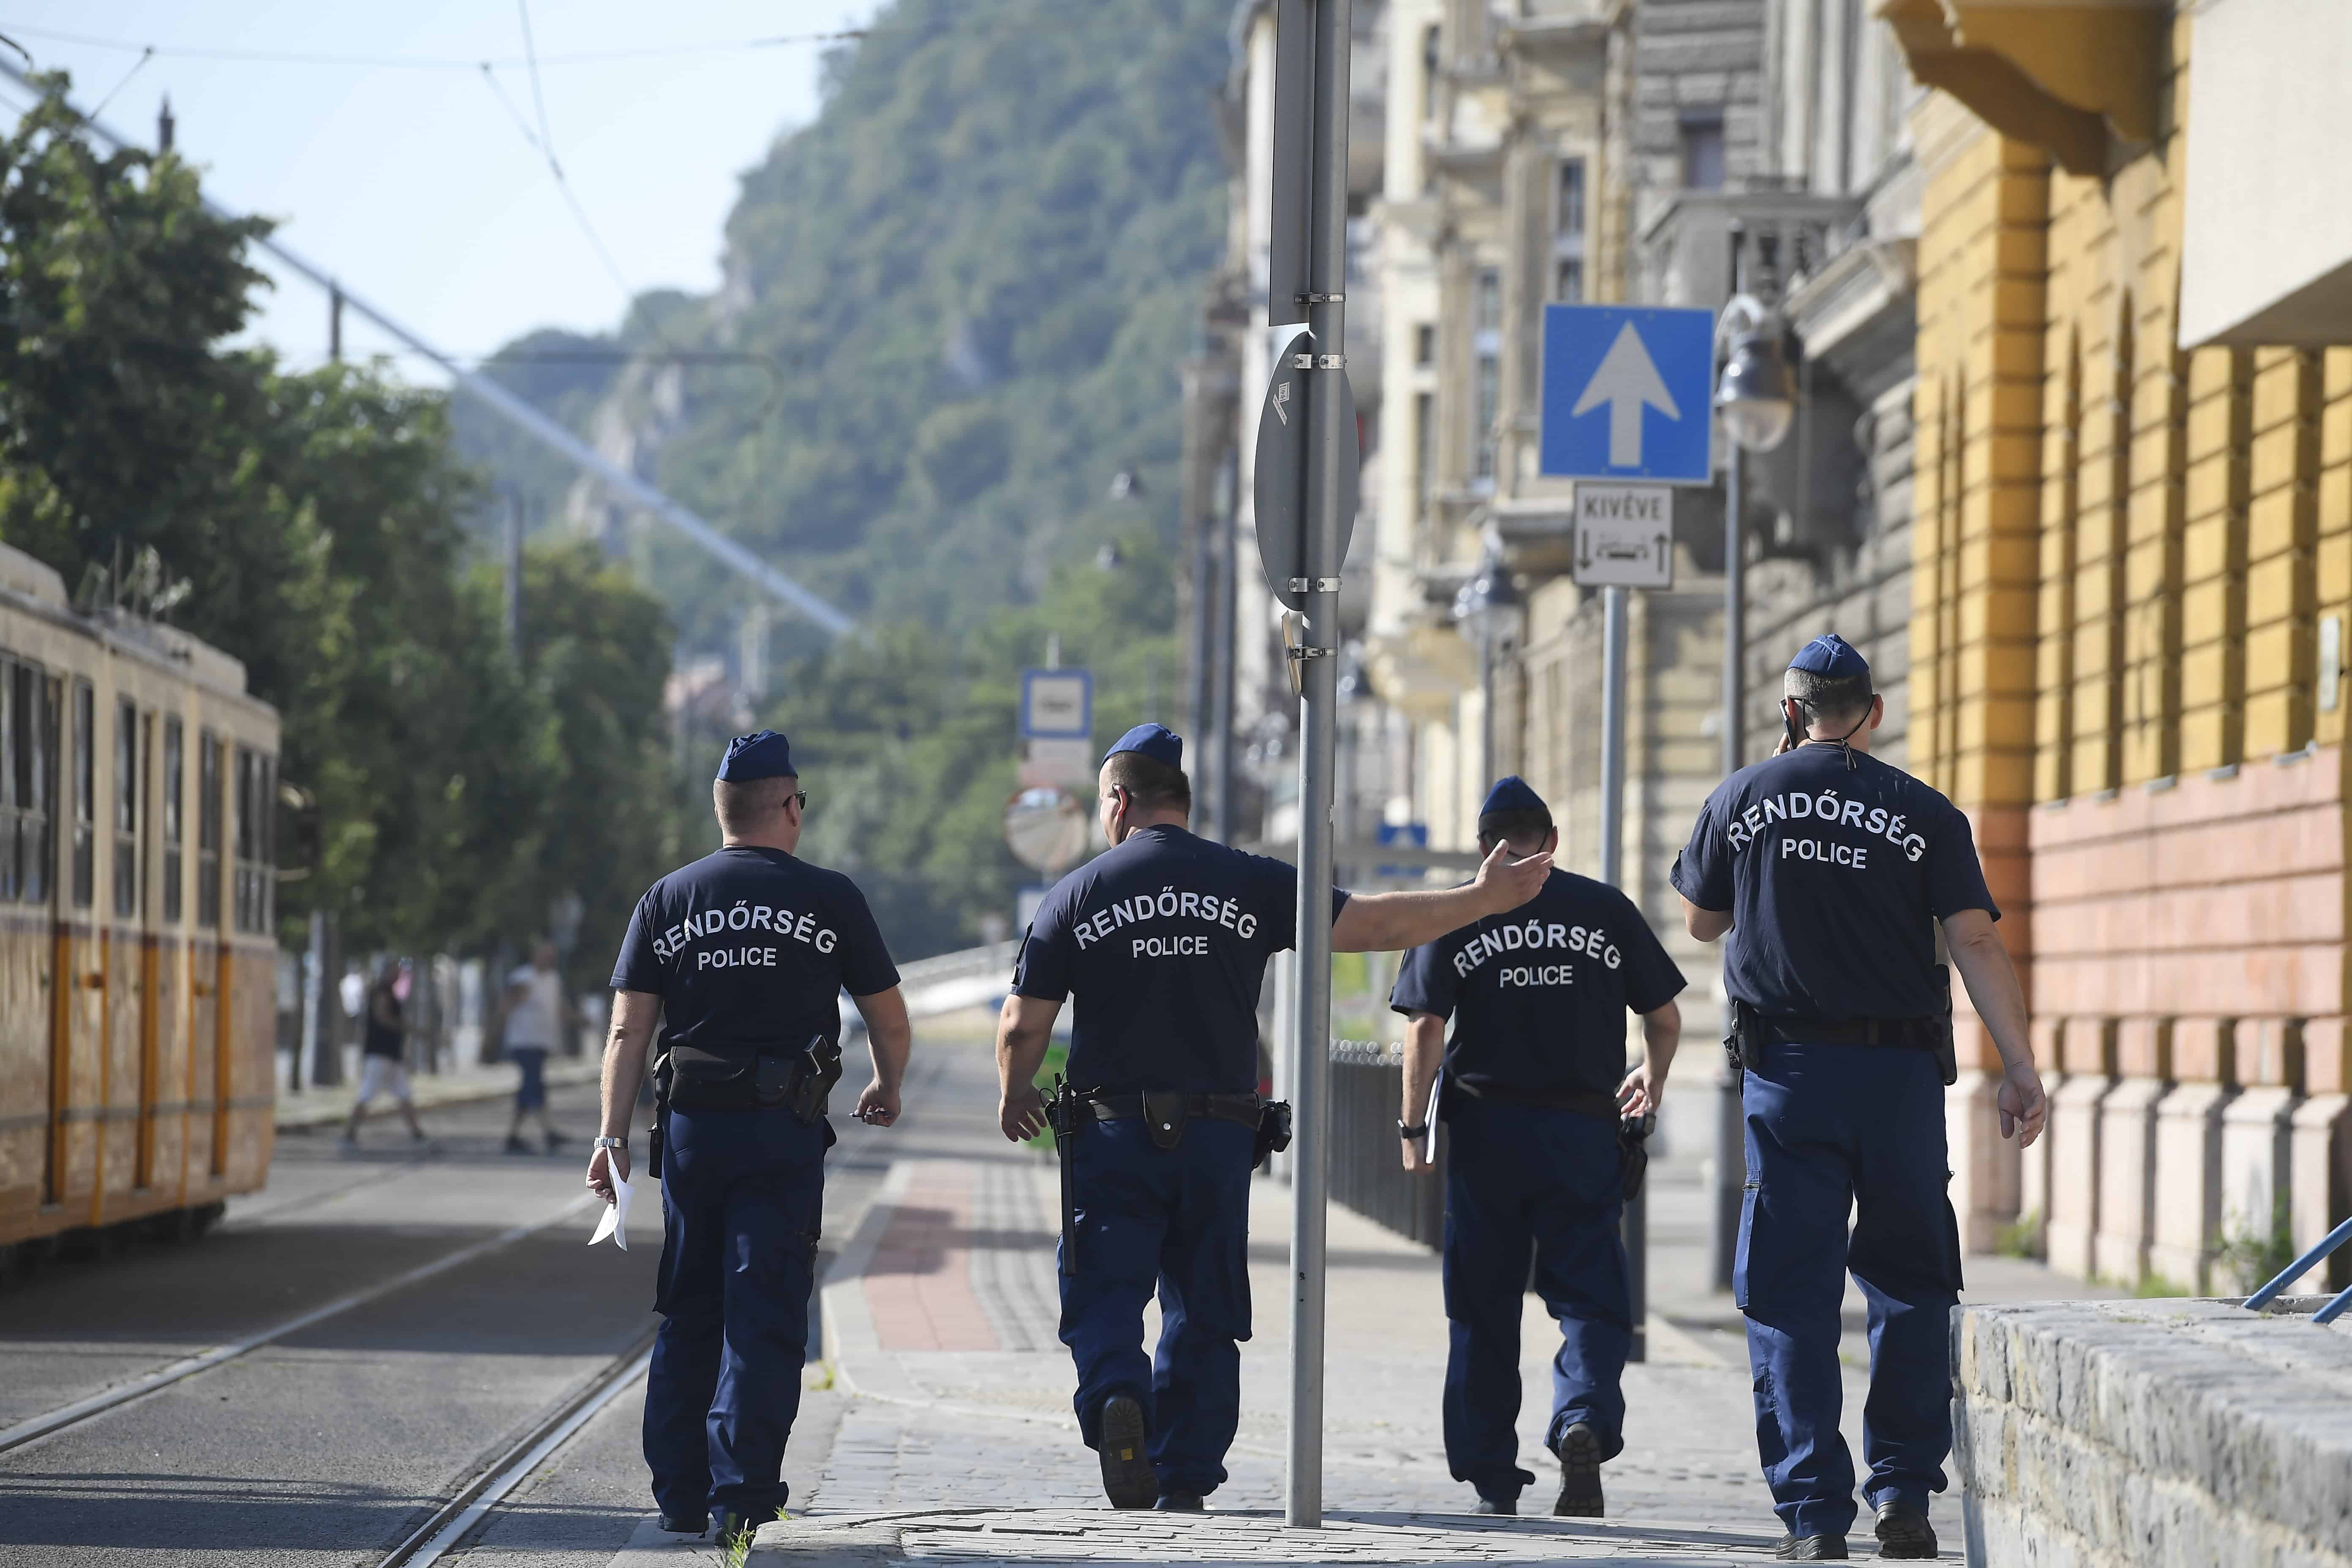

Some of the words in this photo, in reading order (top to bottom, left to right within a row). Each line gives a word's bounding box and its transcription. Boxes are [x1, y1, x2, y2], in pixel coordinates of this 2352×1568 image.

[1584, 491, 1662, 520] KIVÉVE
[1728, 789, 1926, 862] RENDŐRSÉG
[1782, 838, 1867, 869] POLICE
[653, 900, 837, 965] RENDŐRSÉG
[1073, 885, 1257, 950] RENDŐRSÉG
[698, 947, 777, 971] POLICE
[1132, 936, 1208, 958] POLICE
[1453, 919, 1622, 979] RENDŐRSÉG
[1499, 965, 1573, 988] POLICE
